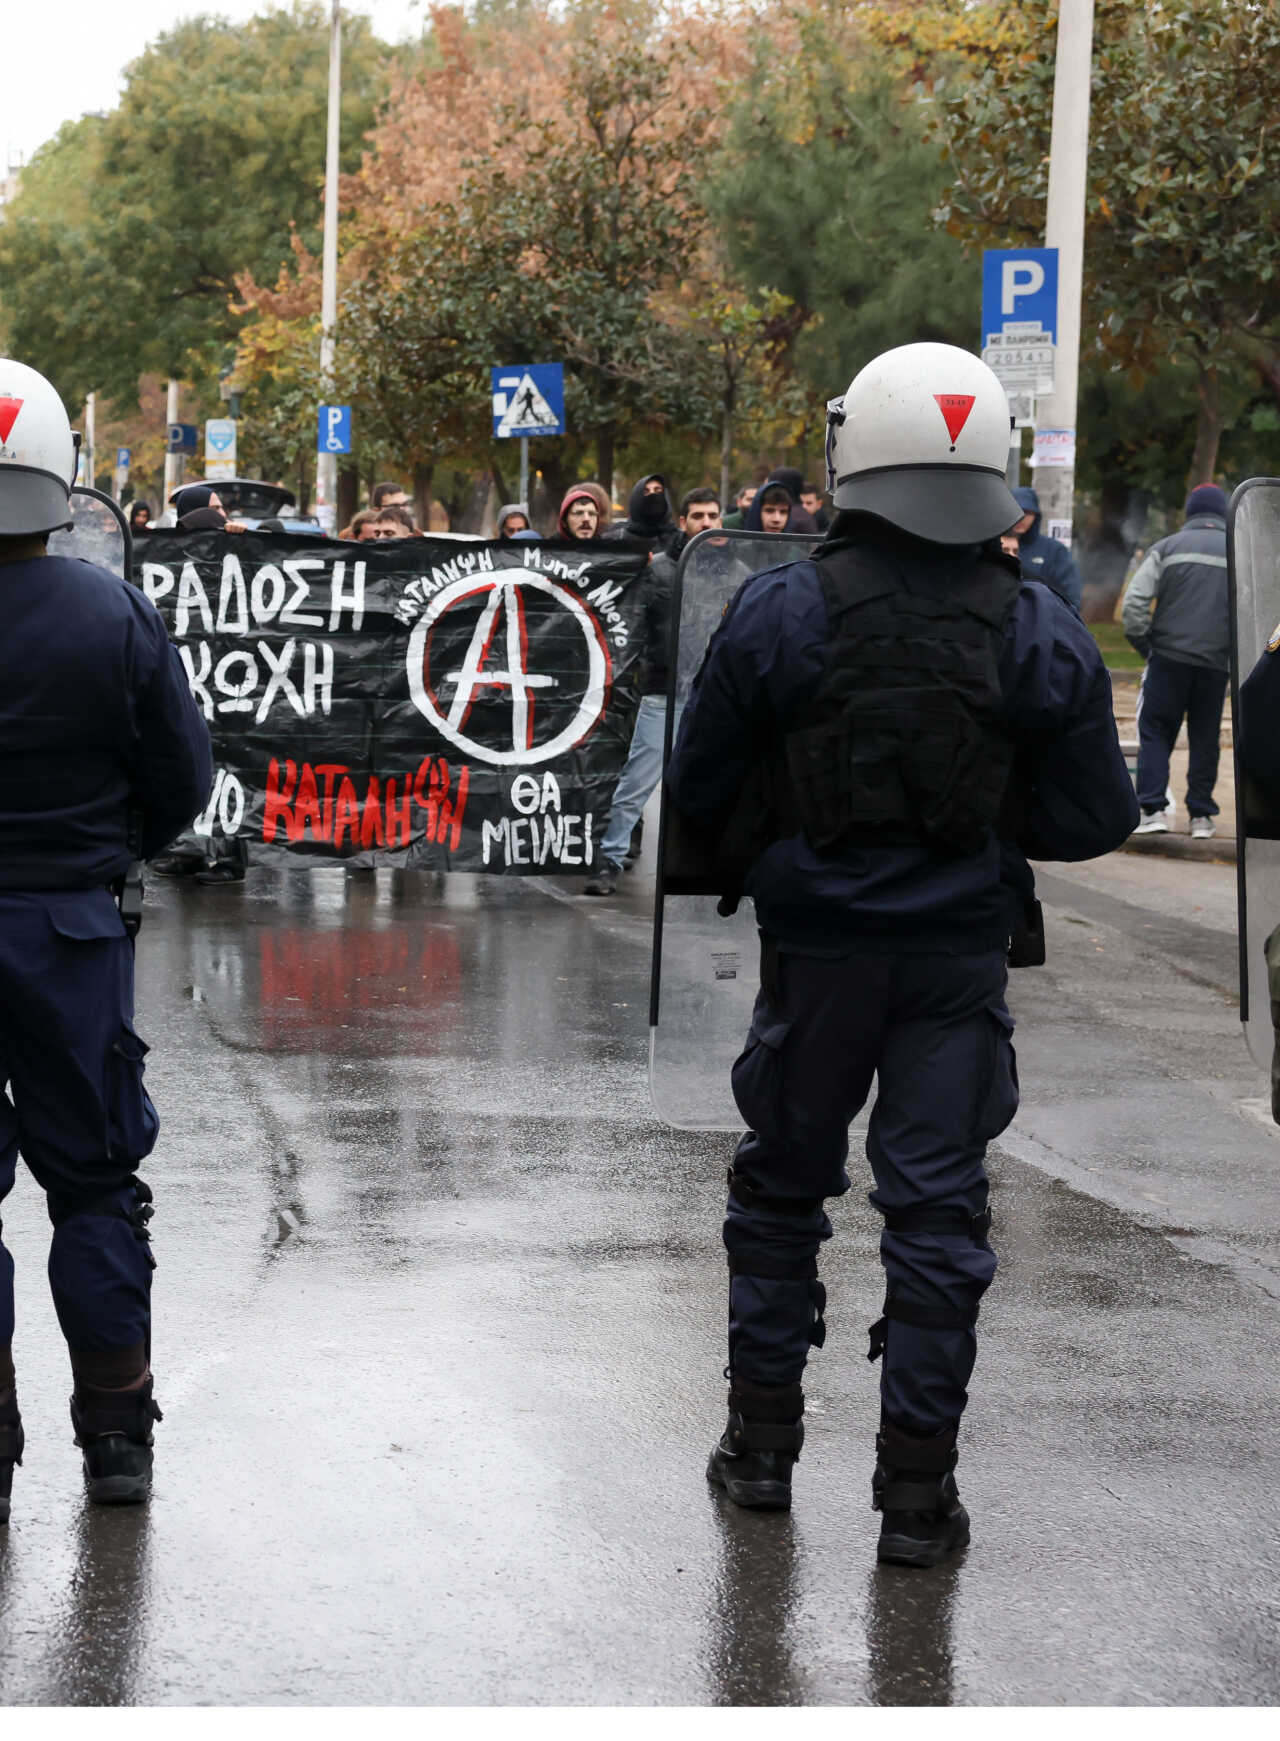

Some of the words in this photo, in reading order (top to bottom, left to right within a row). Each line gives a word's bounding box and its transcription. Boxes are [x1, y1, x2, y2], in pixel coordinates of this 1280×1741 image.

[1001, 260, 1045, 315] P
[169, 426, 184, 453] P
[328, 407, 343, 430] P
[523, 547, 592, 588] Mundo
[586, 580, 629, 648] Nuevo
[262, 756, 470, 853] ΚΑΤΑΛΗΨΗ
[510, 771, 561, 815] ΘΑ
[481, 812, 594, 866] ΜΕΙΝΕΙ
